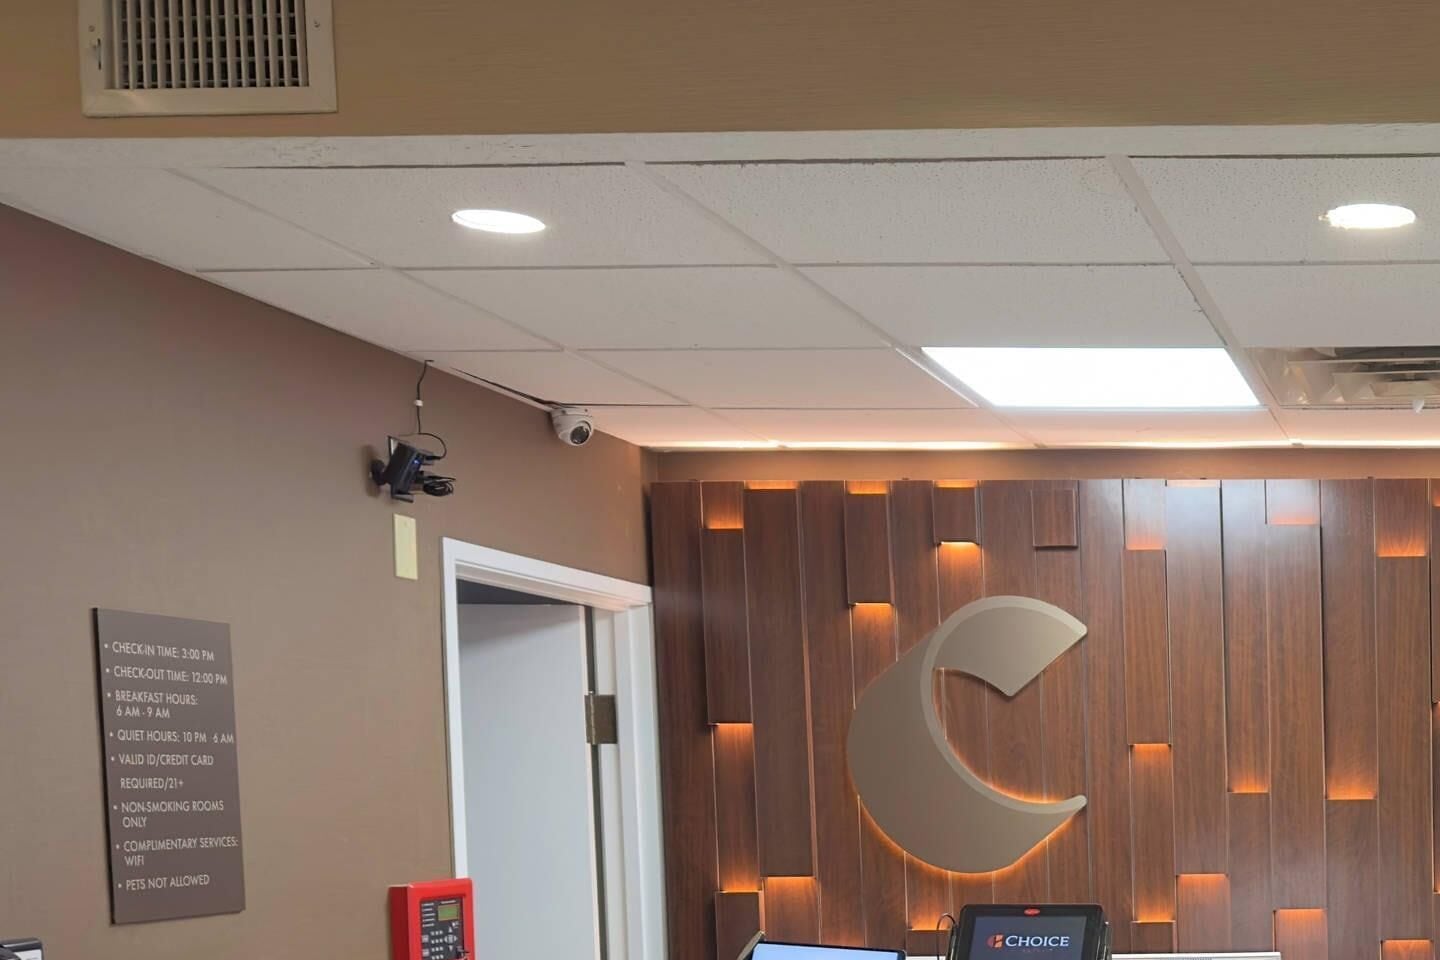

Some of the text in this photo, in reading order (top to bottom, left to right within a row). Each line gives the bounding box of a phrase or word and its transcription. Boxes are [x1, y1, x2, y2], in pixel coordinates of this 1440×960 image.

[112, 641, 215, 661] CHECK-IN TIME: 3:00 PM
[114, 666, 227, 684] CHECK-OUT TIME: 12:00 PM
[115, 690, 198, 705] BREAKFAST HOURS:
[116, 705, 122, 716] 6
[125, 706, 140, 717] AM
[147, 707, 152, 717] 9
[155, 707, 170, 718] AM
[118, 729, 234, 743] QUIET HOURS: 10 PM 6 AM
[119, 753, 214, 767] VALID ID/CREDIT CARD
[120, 778, 184, 791] REQUIRED/21+
[121, 800, 224, 812] NON-SMOKING ROOMS
[122, 817, 147, 828] ONLY
[123, 837, 238, 852] COMPLIMENTARY SERVICES:
[124, 855, 144, 866] WIFI
[126, 875, 210, 890] PETS NOT ALLOWED
[1005, 936, 1070, 947] CHOICE
